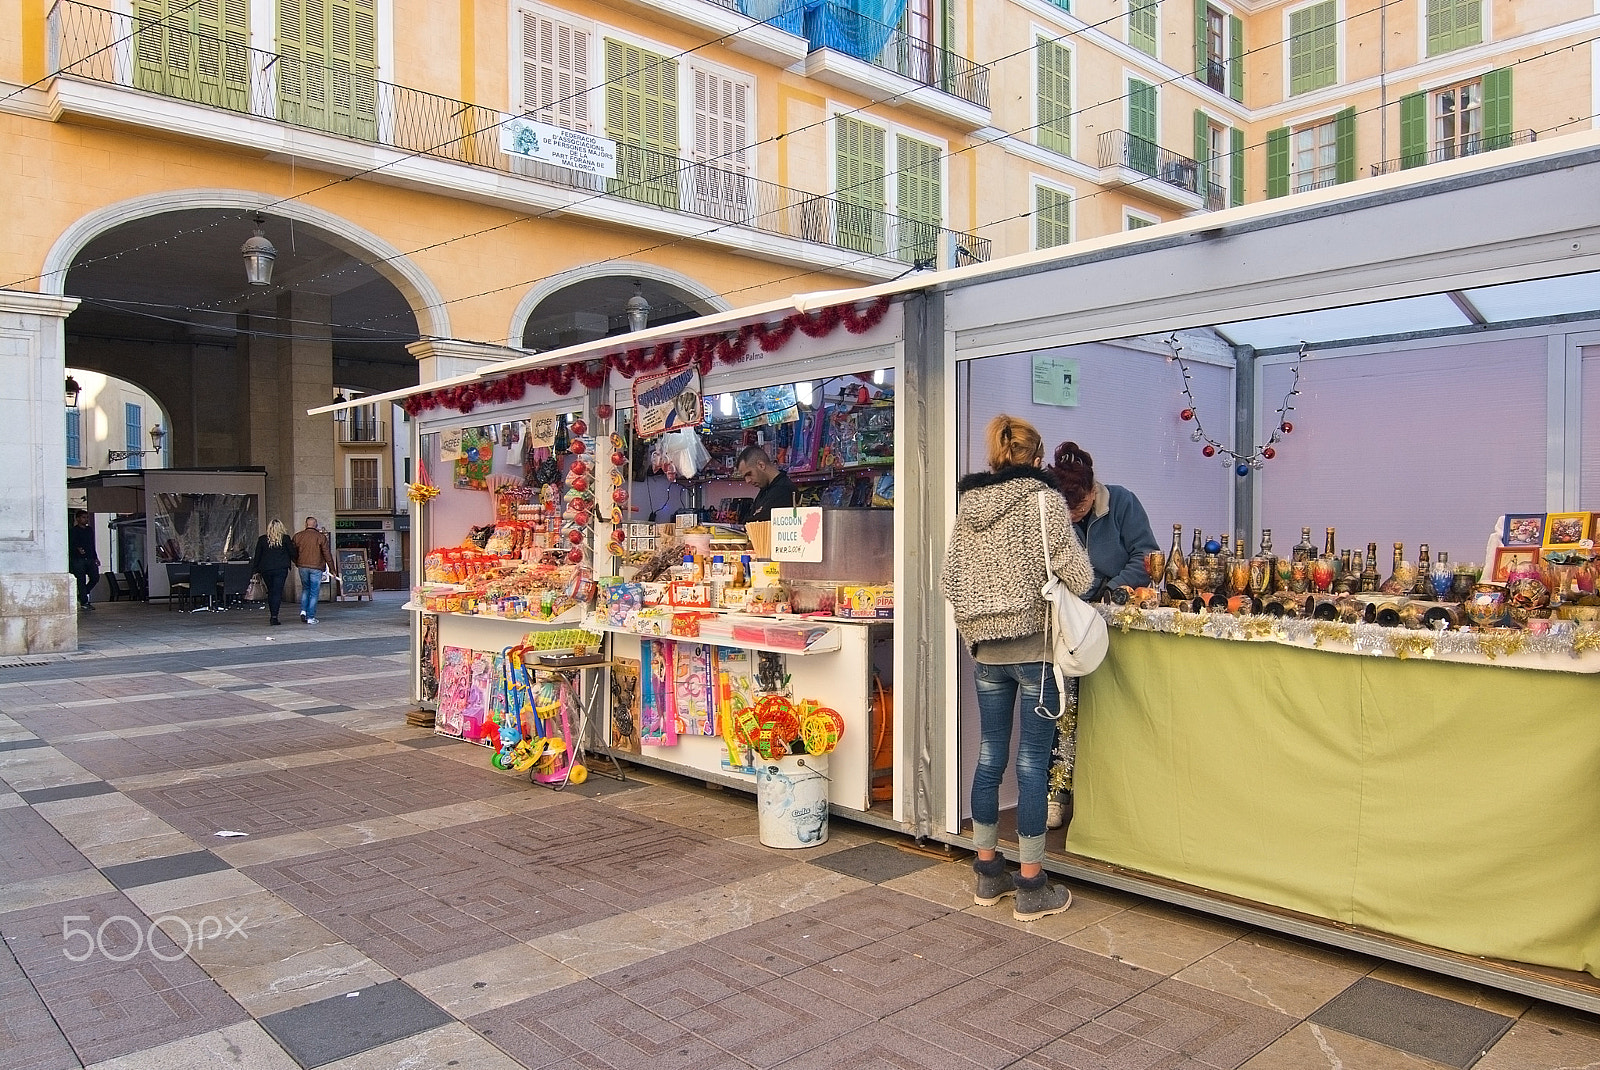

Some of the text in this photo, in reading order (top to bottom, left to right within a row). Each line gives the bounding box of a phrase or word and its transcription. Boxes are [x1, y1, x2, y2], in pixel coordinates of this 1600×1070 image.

[552, 134, 605, 152] D'ASSOCIACIONS
[561, 130, 596, 144] FEDERACIÓ
[553, 140, 587, 153] PERSONES
[587, 149, 613, 160] MAJORS
[552, 152, 568, 160] PART
[570, 155, 596, 167] FORANA
[561, 160, 596, 172] MALLORCA
[745, 352, 764, 362] Palma
[777, 531, 798, 541] DULCE
